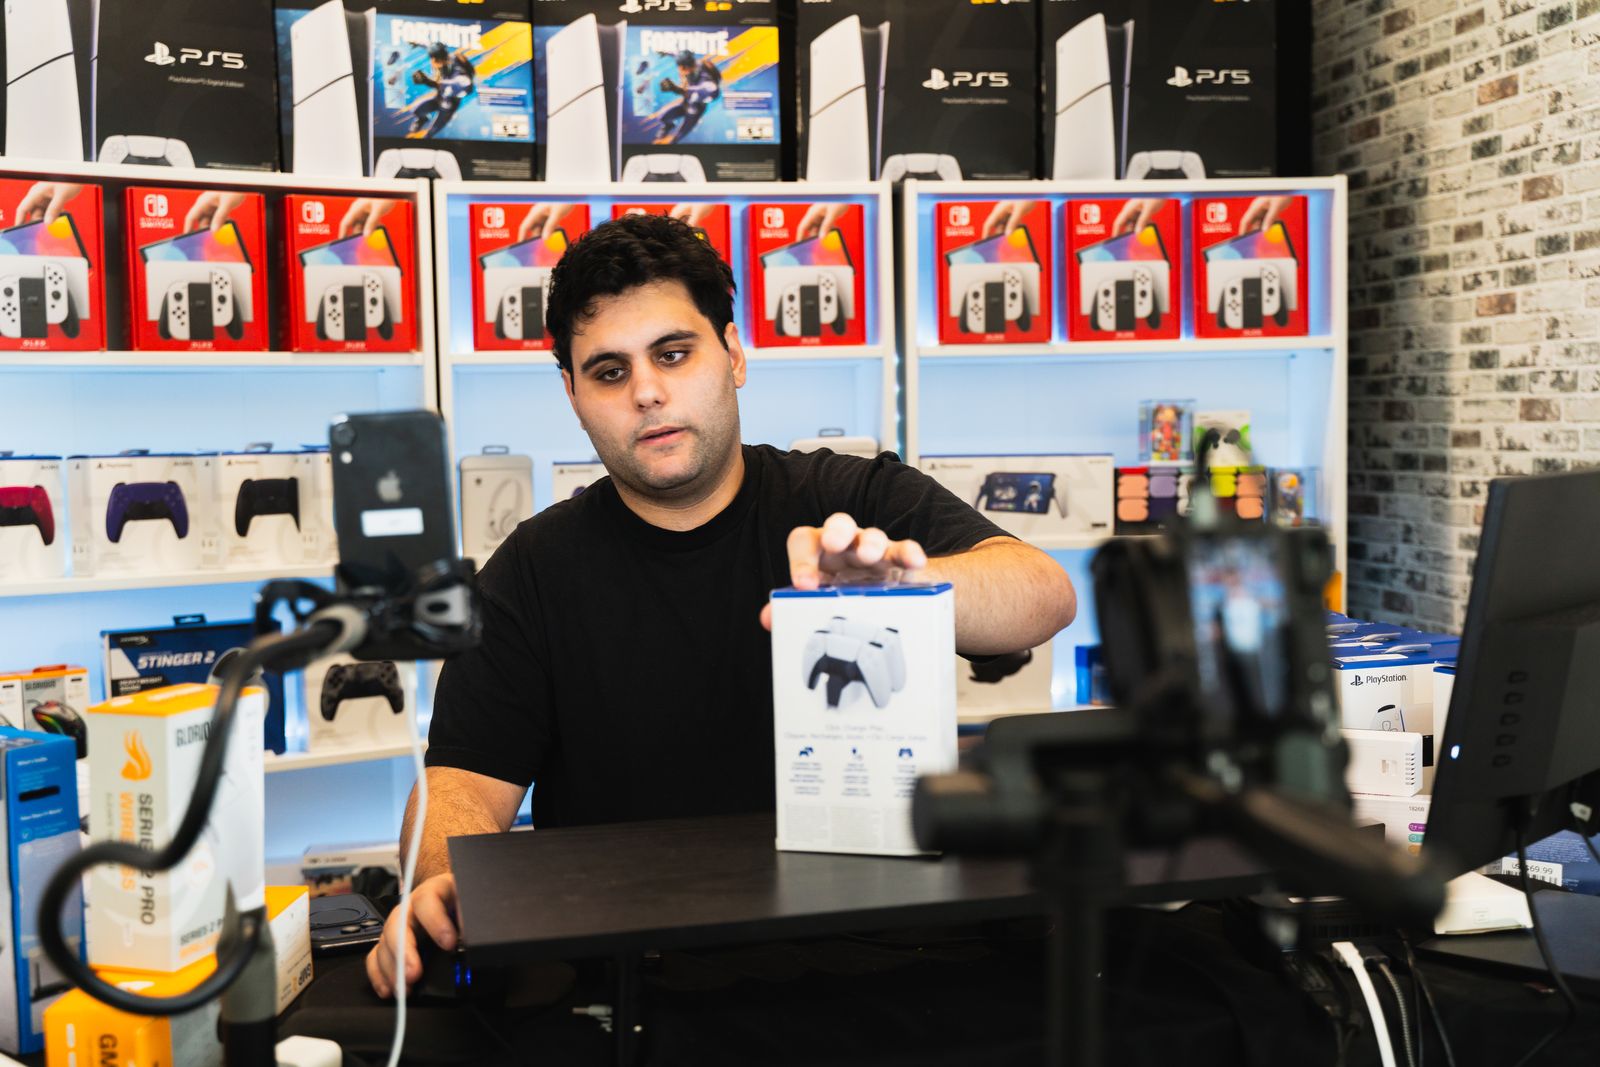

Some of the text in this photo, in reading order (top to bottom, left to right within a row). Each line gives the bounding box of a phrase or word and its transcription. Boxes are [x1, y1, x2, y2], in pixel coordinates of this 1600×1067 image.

[180, 48, 245, 69] PS5
[953, 71, 1010, 87] PS5
[1196, 69, 1251, 85] PS5
[137, 650, 216, 670] STINGER 2
[1366, 674, 1407, 685] PlayStation
[138, 793, 154, 852] SERIE
[140, 886, 155, 925] PRO
